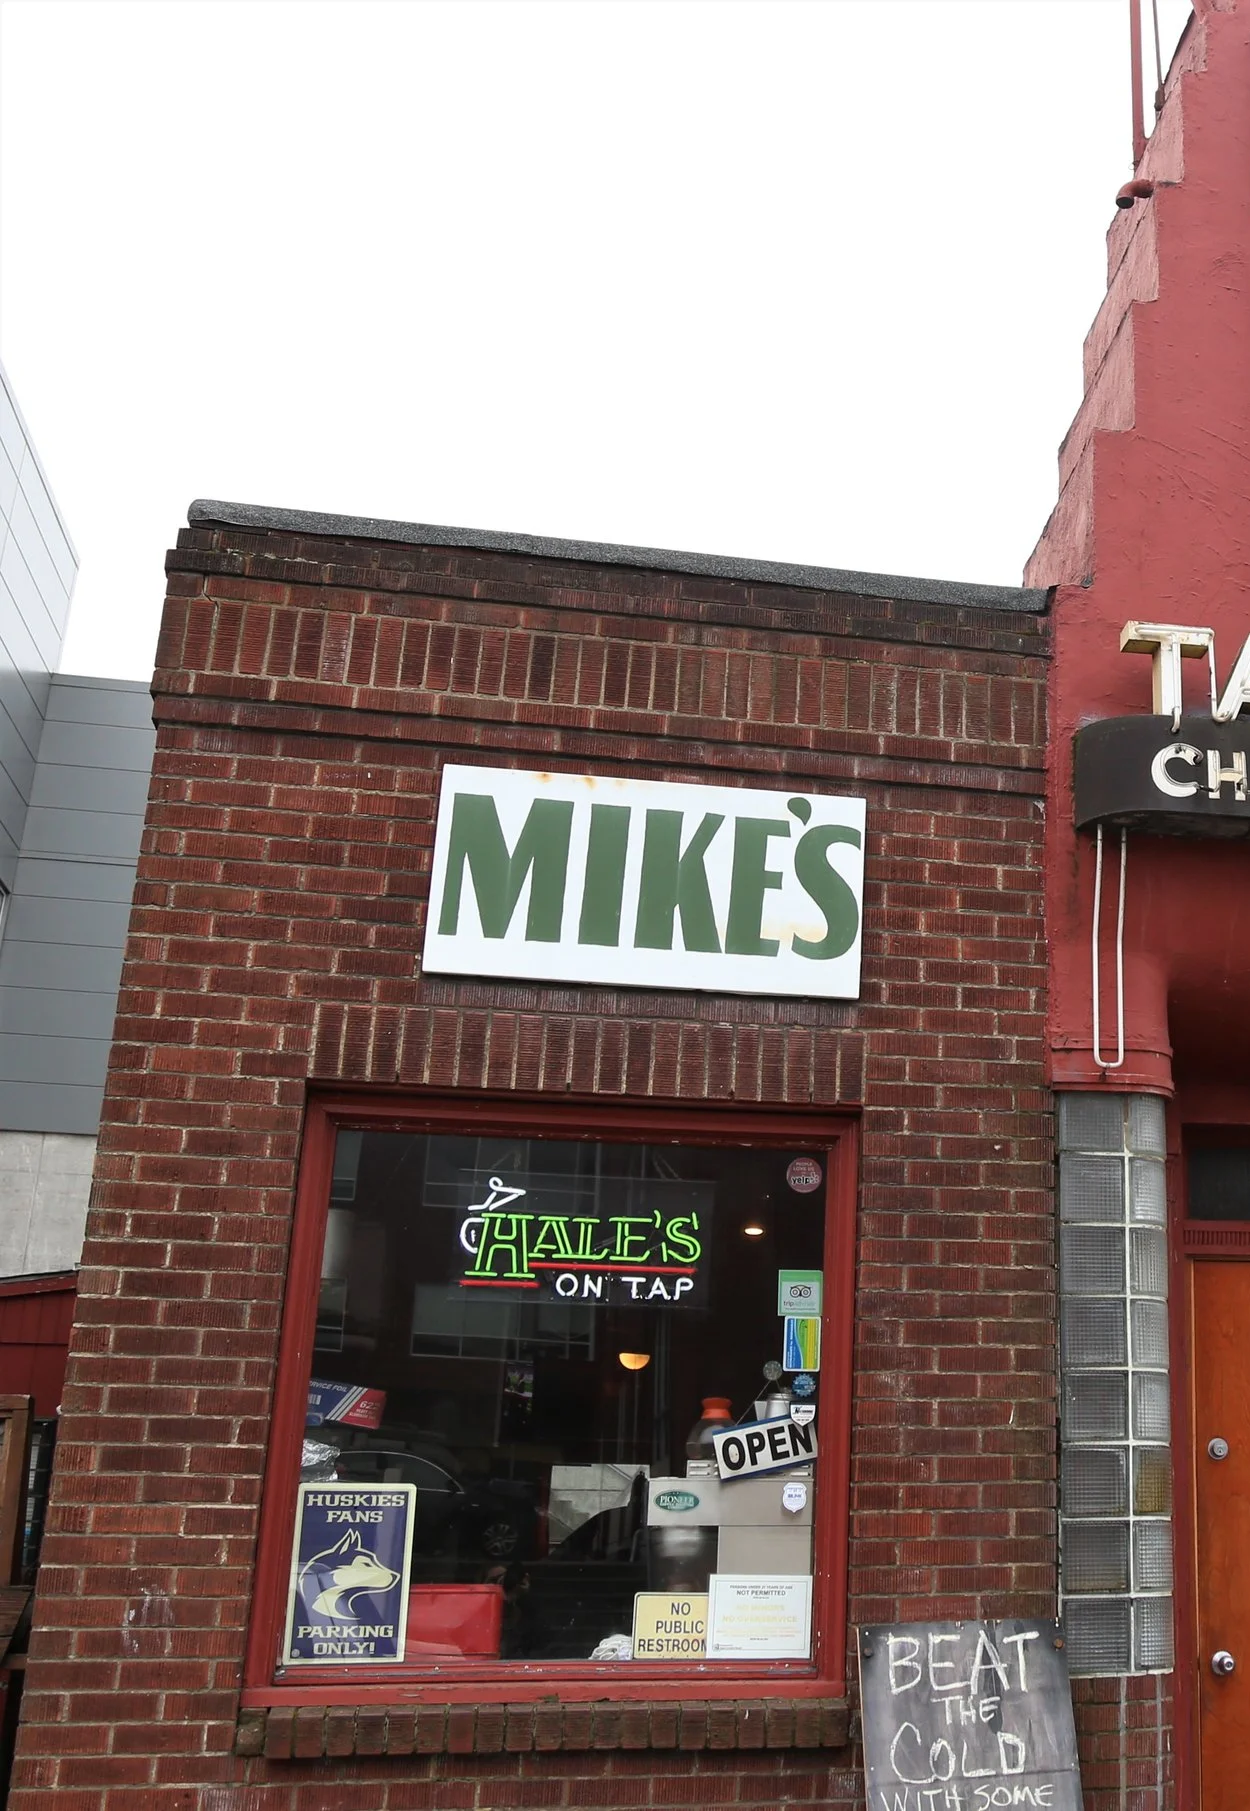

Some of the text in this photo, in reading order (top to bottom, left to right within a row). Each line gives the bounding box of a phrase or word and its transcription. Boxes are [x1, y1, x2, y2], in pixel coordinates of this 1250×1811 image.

[437, 793, 862, 961] MIKE'S
[791, 1175, 811, 1186] yelp
[464, 1209, 701, 1278] HALE'S
[555, 1273, 695, 1300] ON TAP
[721, 1423, 814, 1471] OPEN
[306, 1493, 405, 1507] HUSKIES
[326, 1510, 383, 1523] FANS
[670, 1601, 691, 1616] NO
[297, 1625, 394, 1639] PARKING
[655, 1619, 704, 1634] PUBLIC
[313, 1641, 375, 1655] ONLY!
[886, 1629, 1040, 1695] BEAT
[930, 1695, 1001, 1725] THE
[890, 1722, 1026, 1784] COLD
[880, 1783, 1055, 1811] WITH SOME
